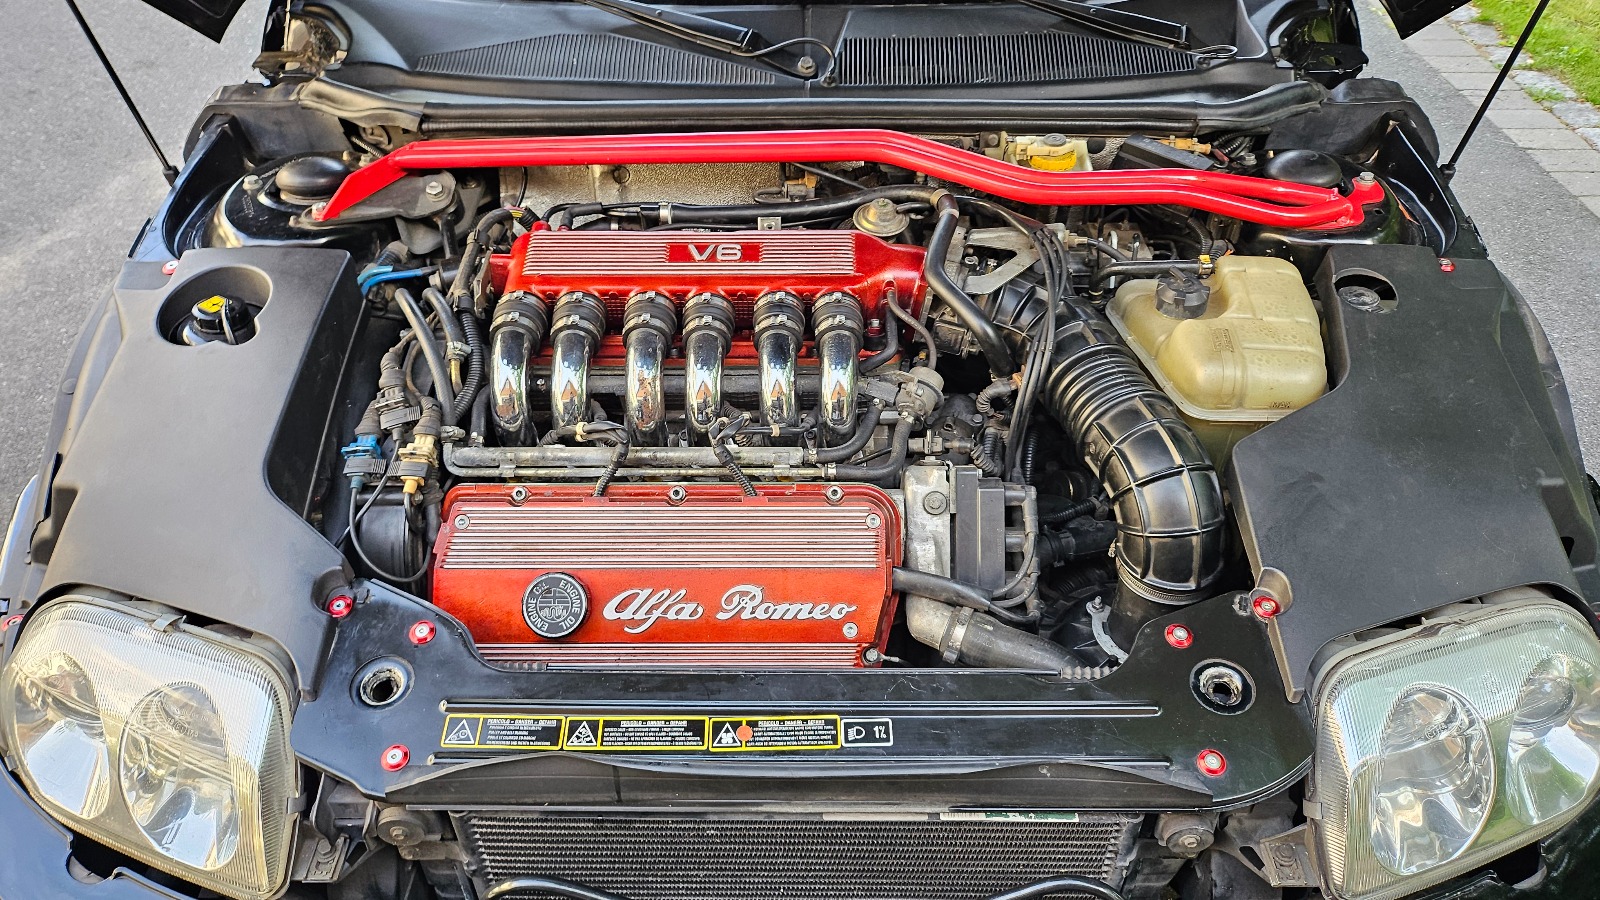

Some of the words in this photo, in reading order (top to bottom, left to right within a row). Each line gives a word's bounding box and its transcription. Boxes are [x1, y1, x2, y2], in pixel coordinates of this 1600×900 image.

[688, 243, 742, 261] V6
[558, 579, 581, 614] ENGINE
[603, 587, 703, 634] Alfa
[716, 584, 857, 621] Romeo
[527, 597, 549, 631] ENGINE
[559, 616, 576, 630] OIL
[872, 725, 887, 740] 1%
